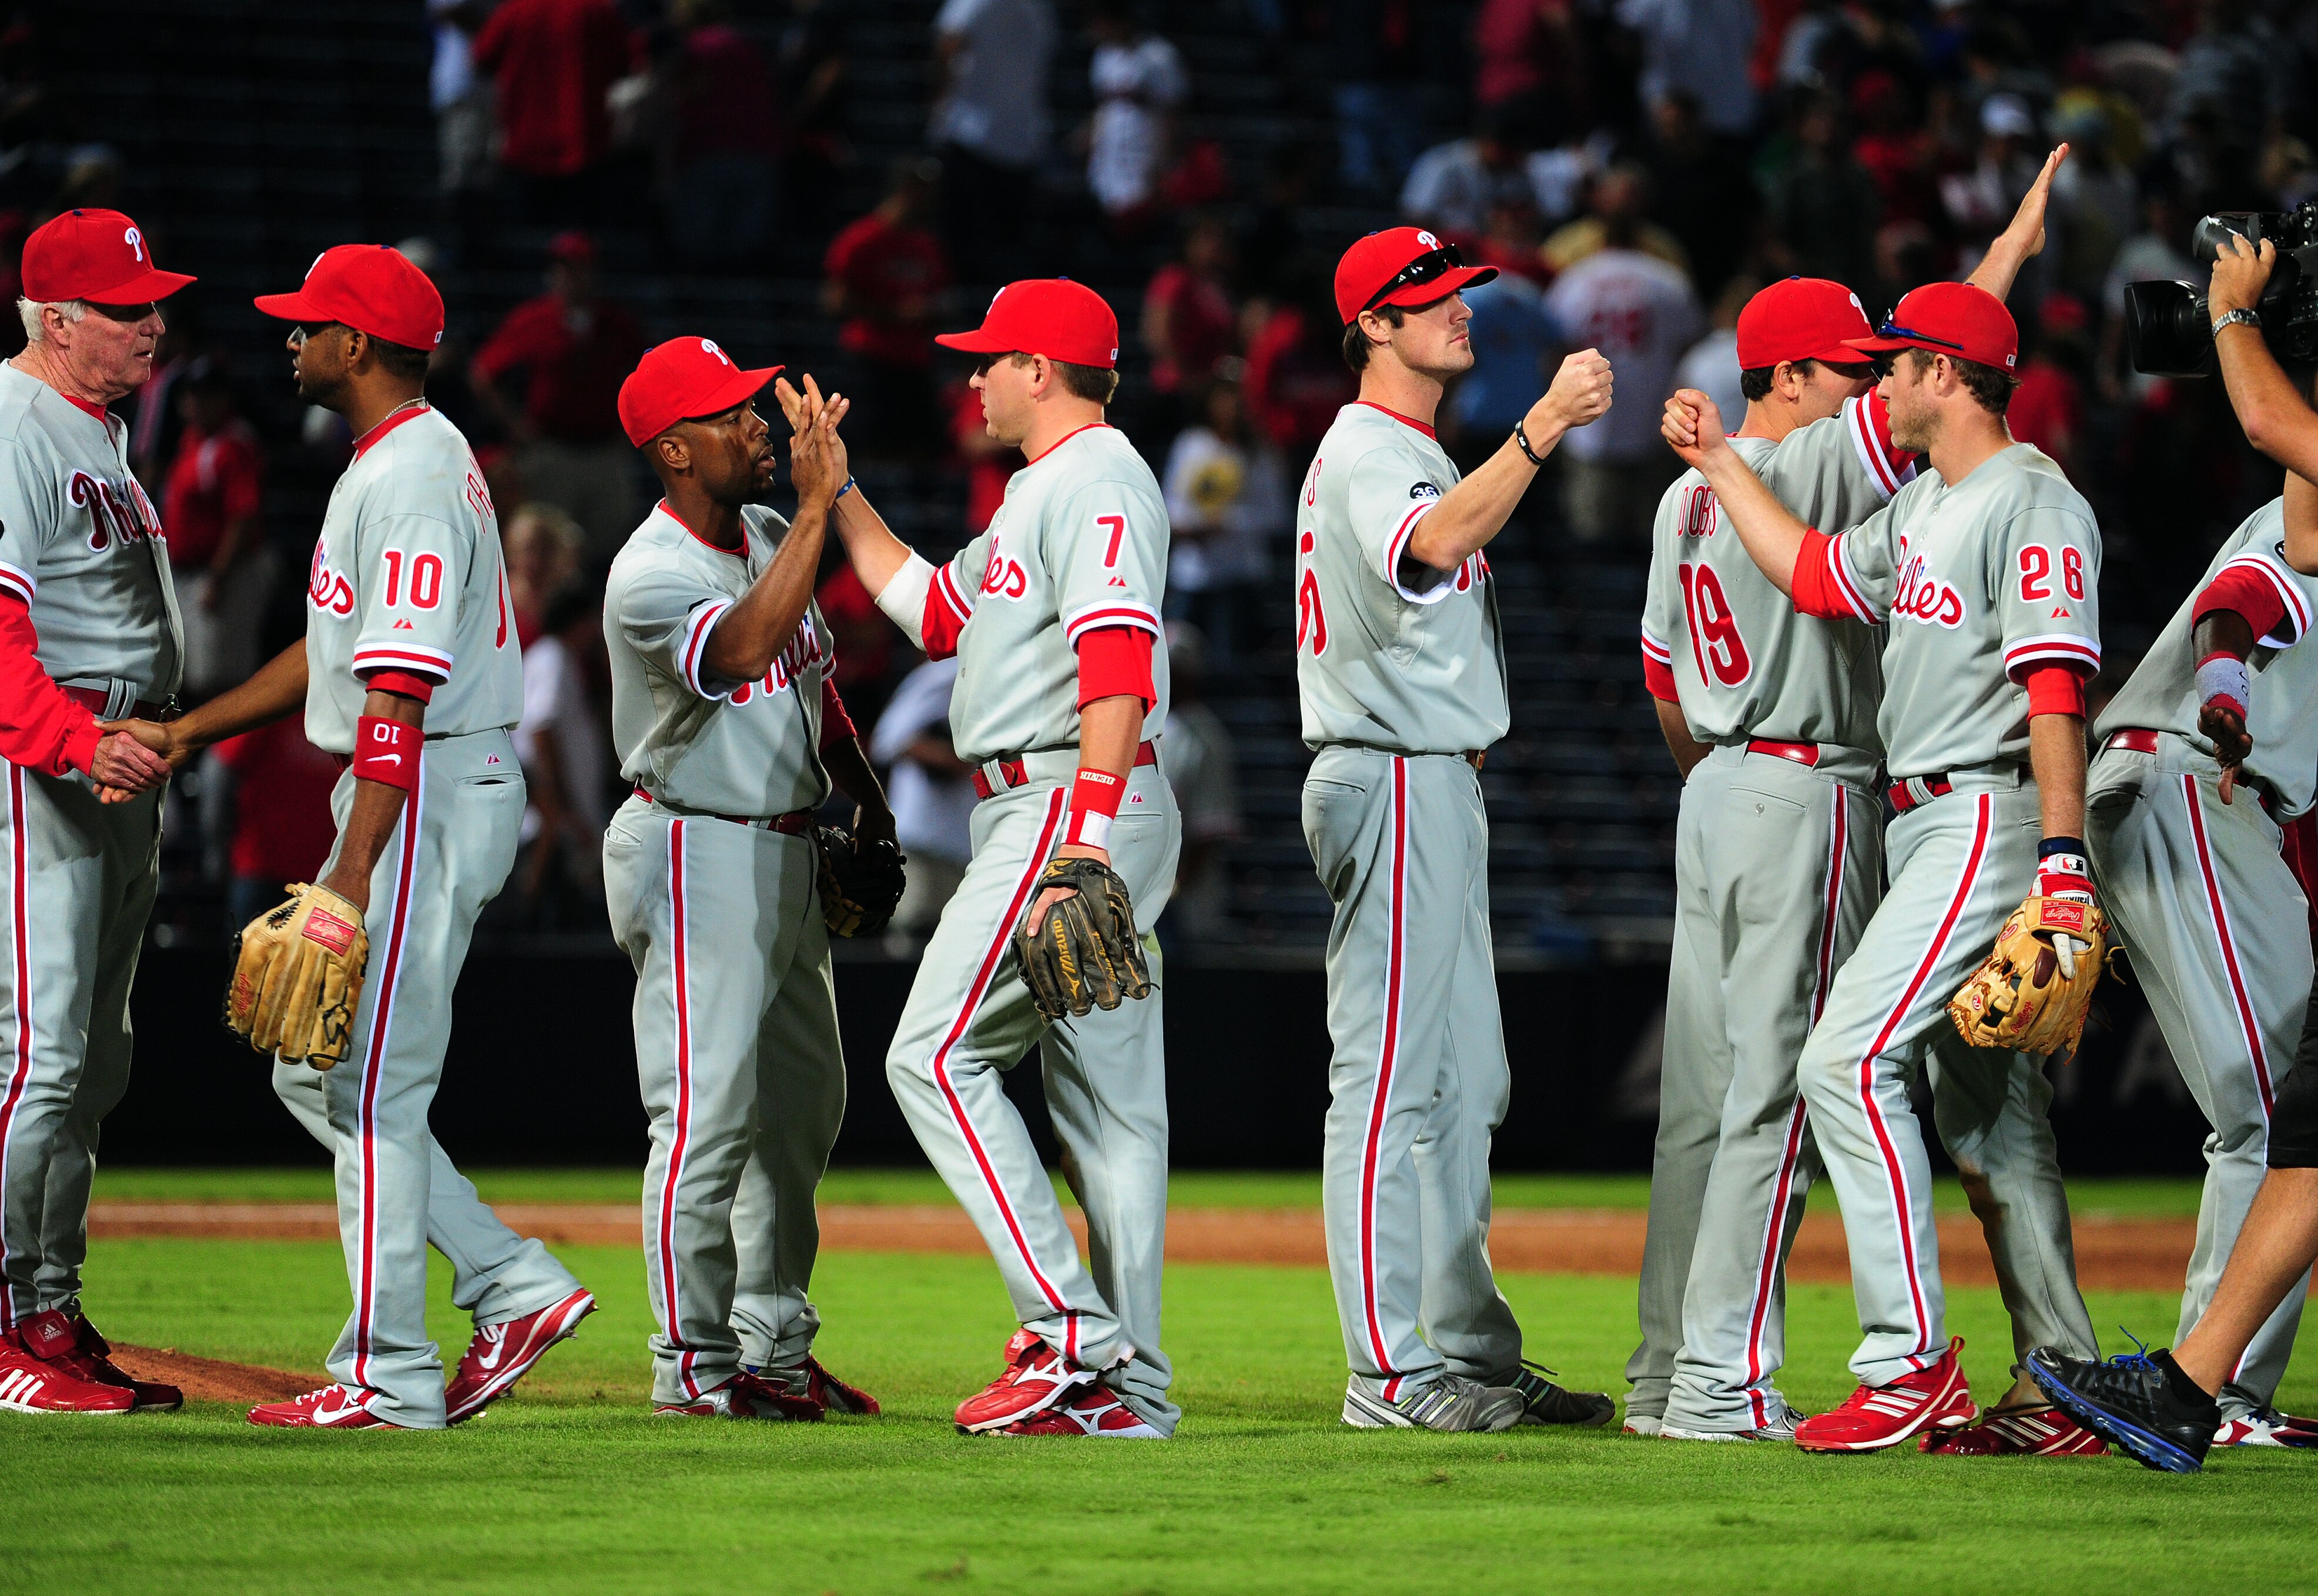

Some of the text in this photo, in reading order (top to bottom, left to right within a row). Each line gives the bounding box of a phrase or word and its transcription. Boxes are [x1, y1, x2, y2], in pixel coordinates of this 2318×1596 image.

[123, 226, 144, 263] P
[1416, 230, 1439, 252] P
[701, 338, 729, 366] P
[1412, 485, 1439, 499] 36
[1093, 512, 1127, 571] 7
[381, 547, 445, 612] 10
[2017, 542, 2085, 603] 26
[1678, 559, 1753, 690] 19
[1053, 919, 1076, 974] MIZUNO
